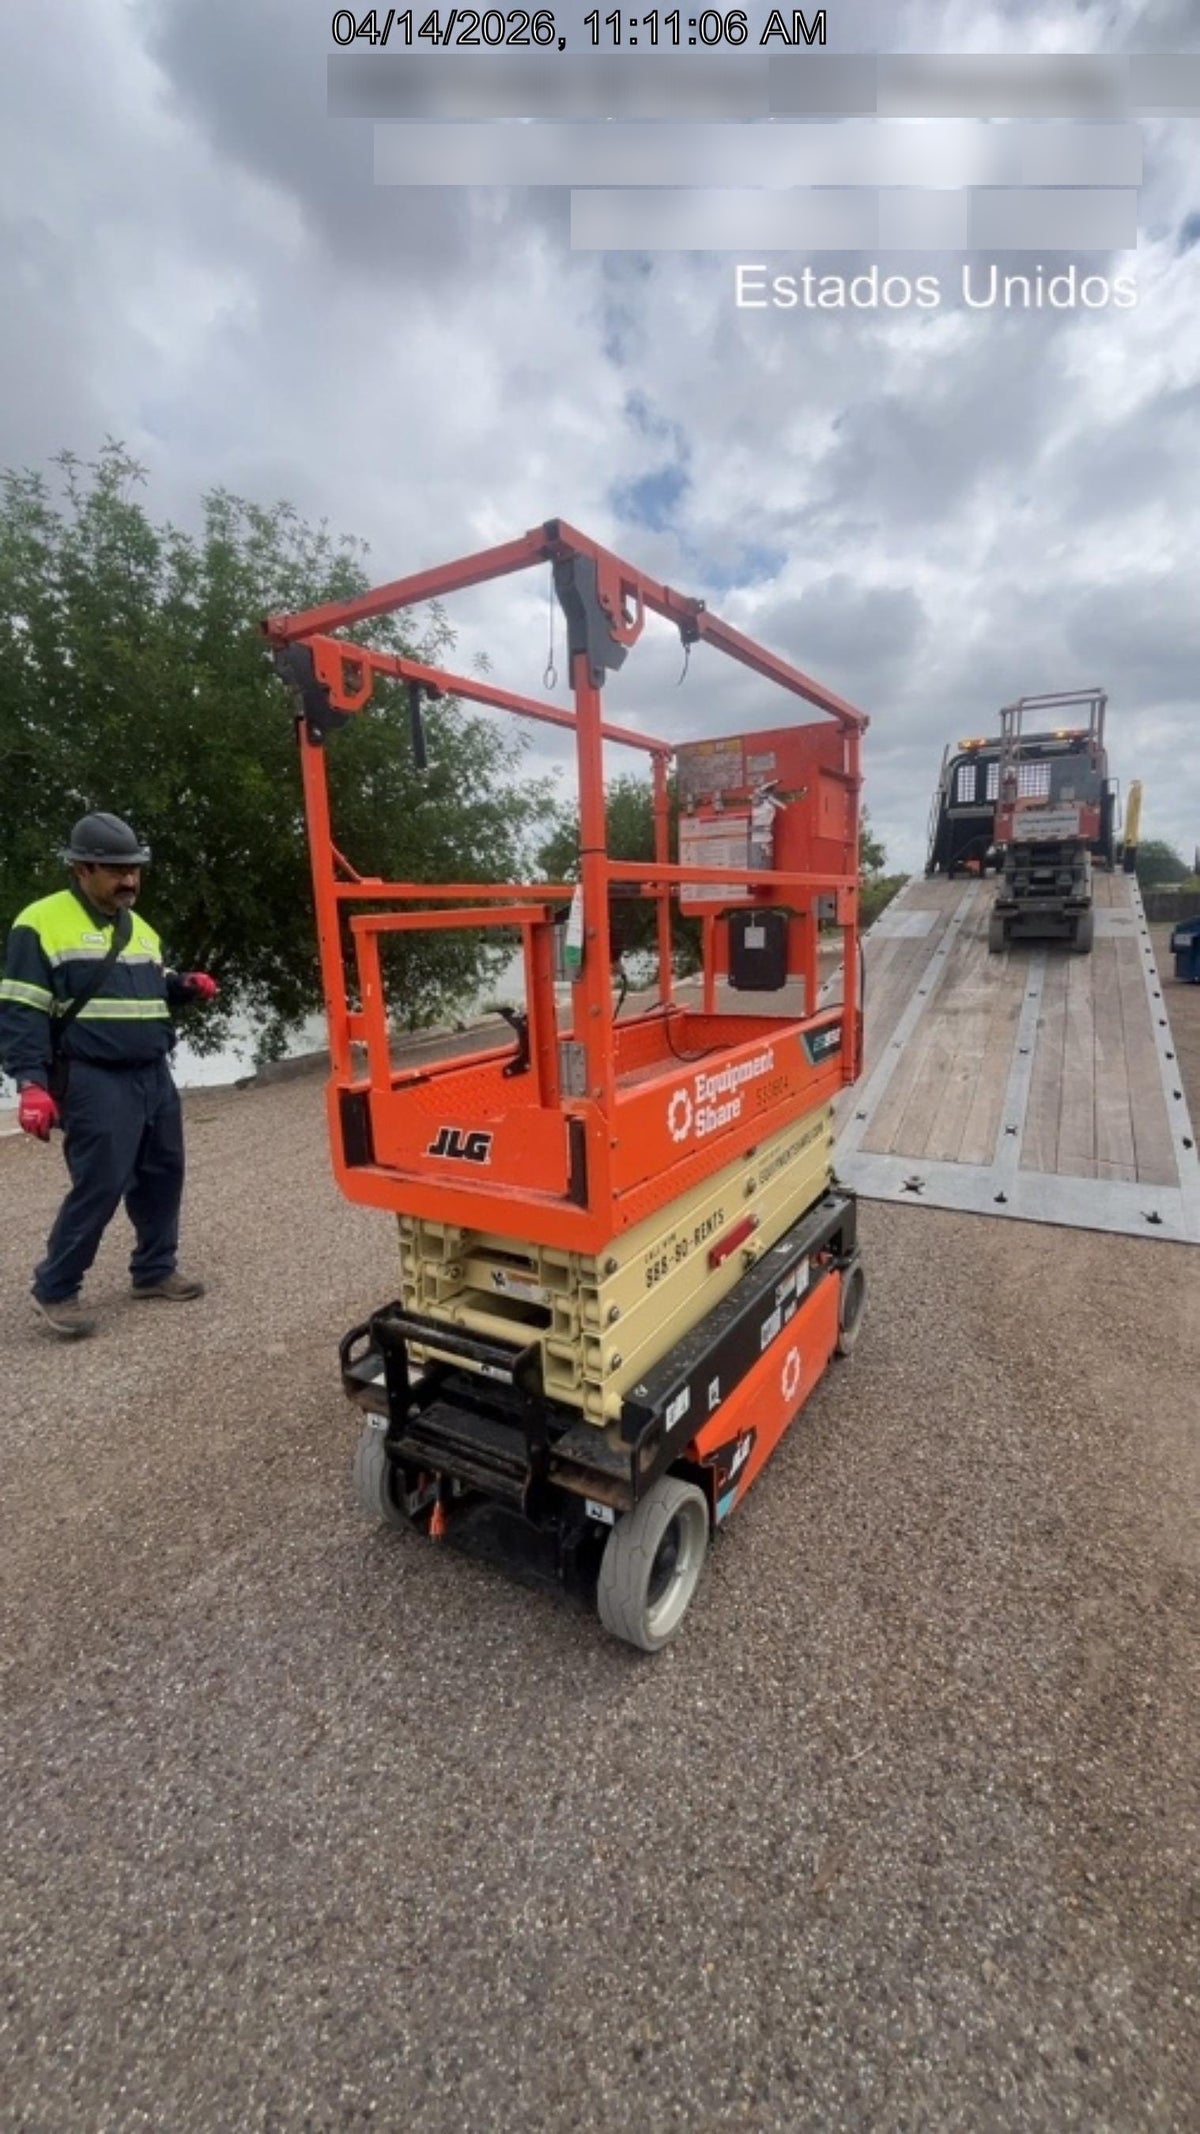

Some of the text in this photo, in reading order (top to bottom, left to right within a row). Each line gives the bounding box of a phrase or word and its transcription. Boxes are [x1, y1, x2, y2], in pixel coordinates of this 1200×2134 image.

[695, 1047, 774, 1103] Equipment
[695, 1098, 741, 1138] Share
[427, 1127, 493, 1164] JLG
